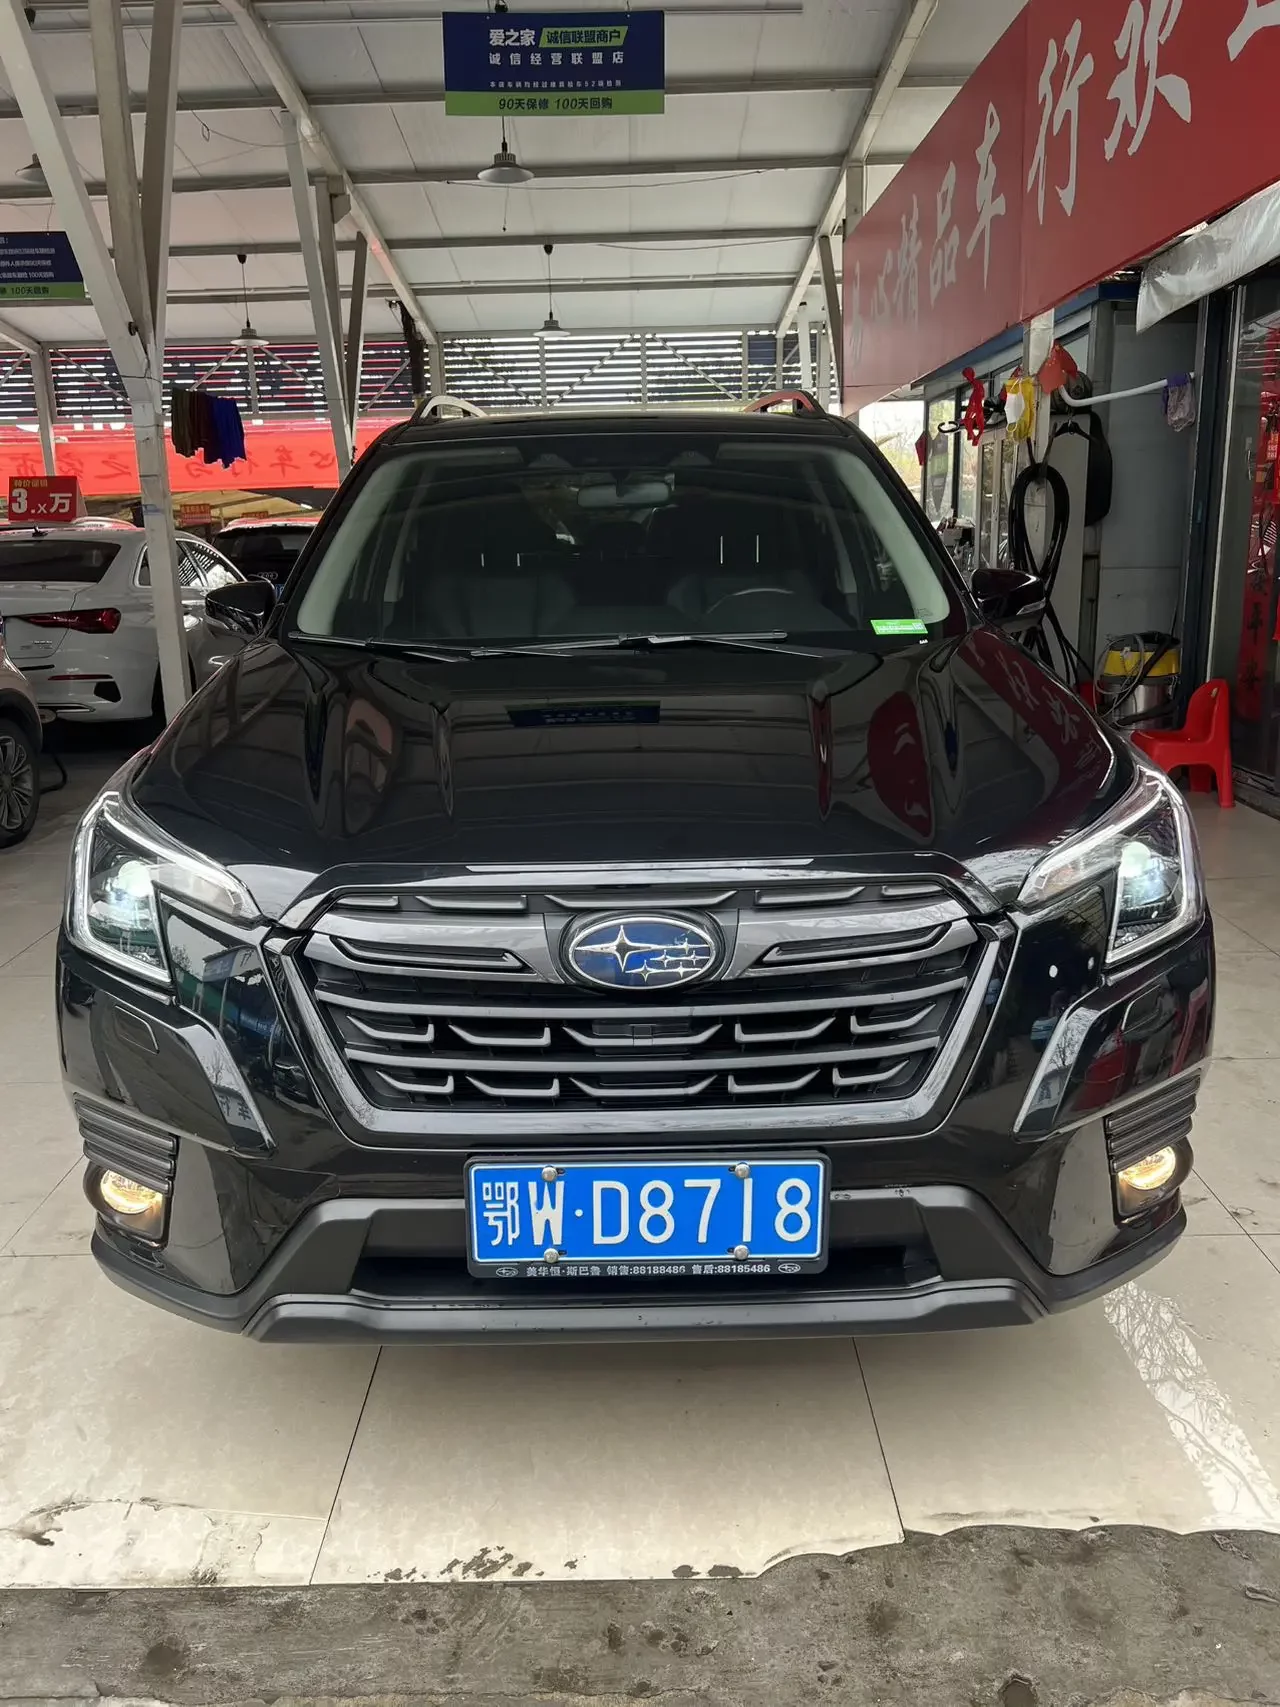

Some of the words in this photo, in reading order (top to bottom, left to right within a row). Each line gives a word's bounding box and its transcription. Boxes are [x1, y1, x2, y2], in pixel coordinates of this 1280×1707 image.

[489, 29, 536, 46] 爱之家
[546, 29, 621, 44] 诚信联盟商户
[489, 51, 624, 65] 诚信经营联盟店
[498, 97, 549, 110] 90天保修
[554, 96, 613, 110] 100天回购
[482, 1177, 812, 1247] 鄂W·D8718
